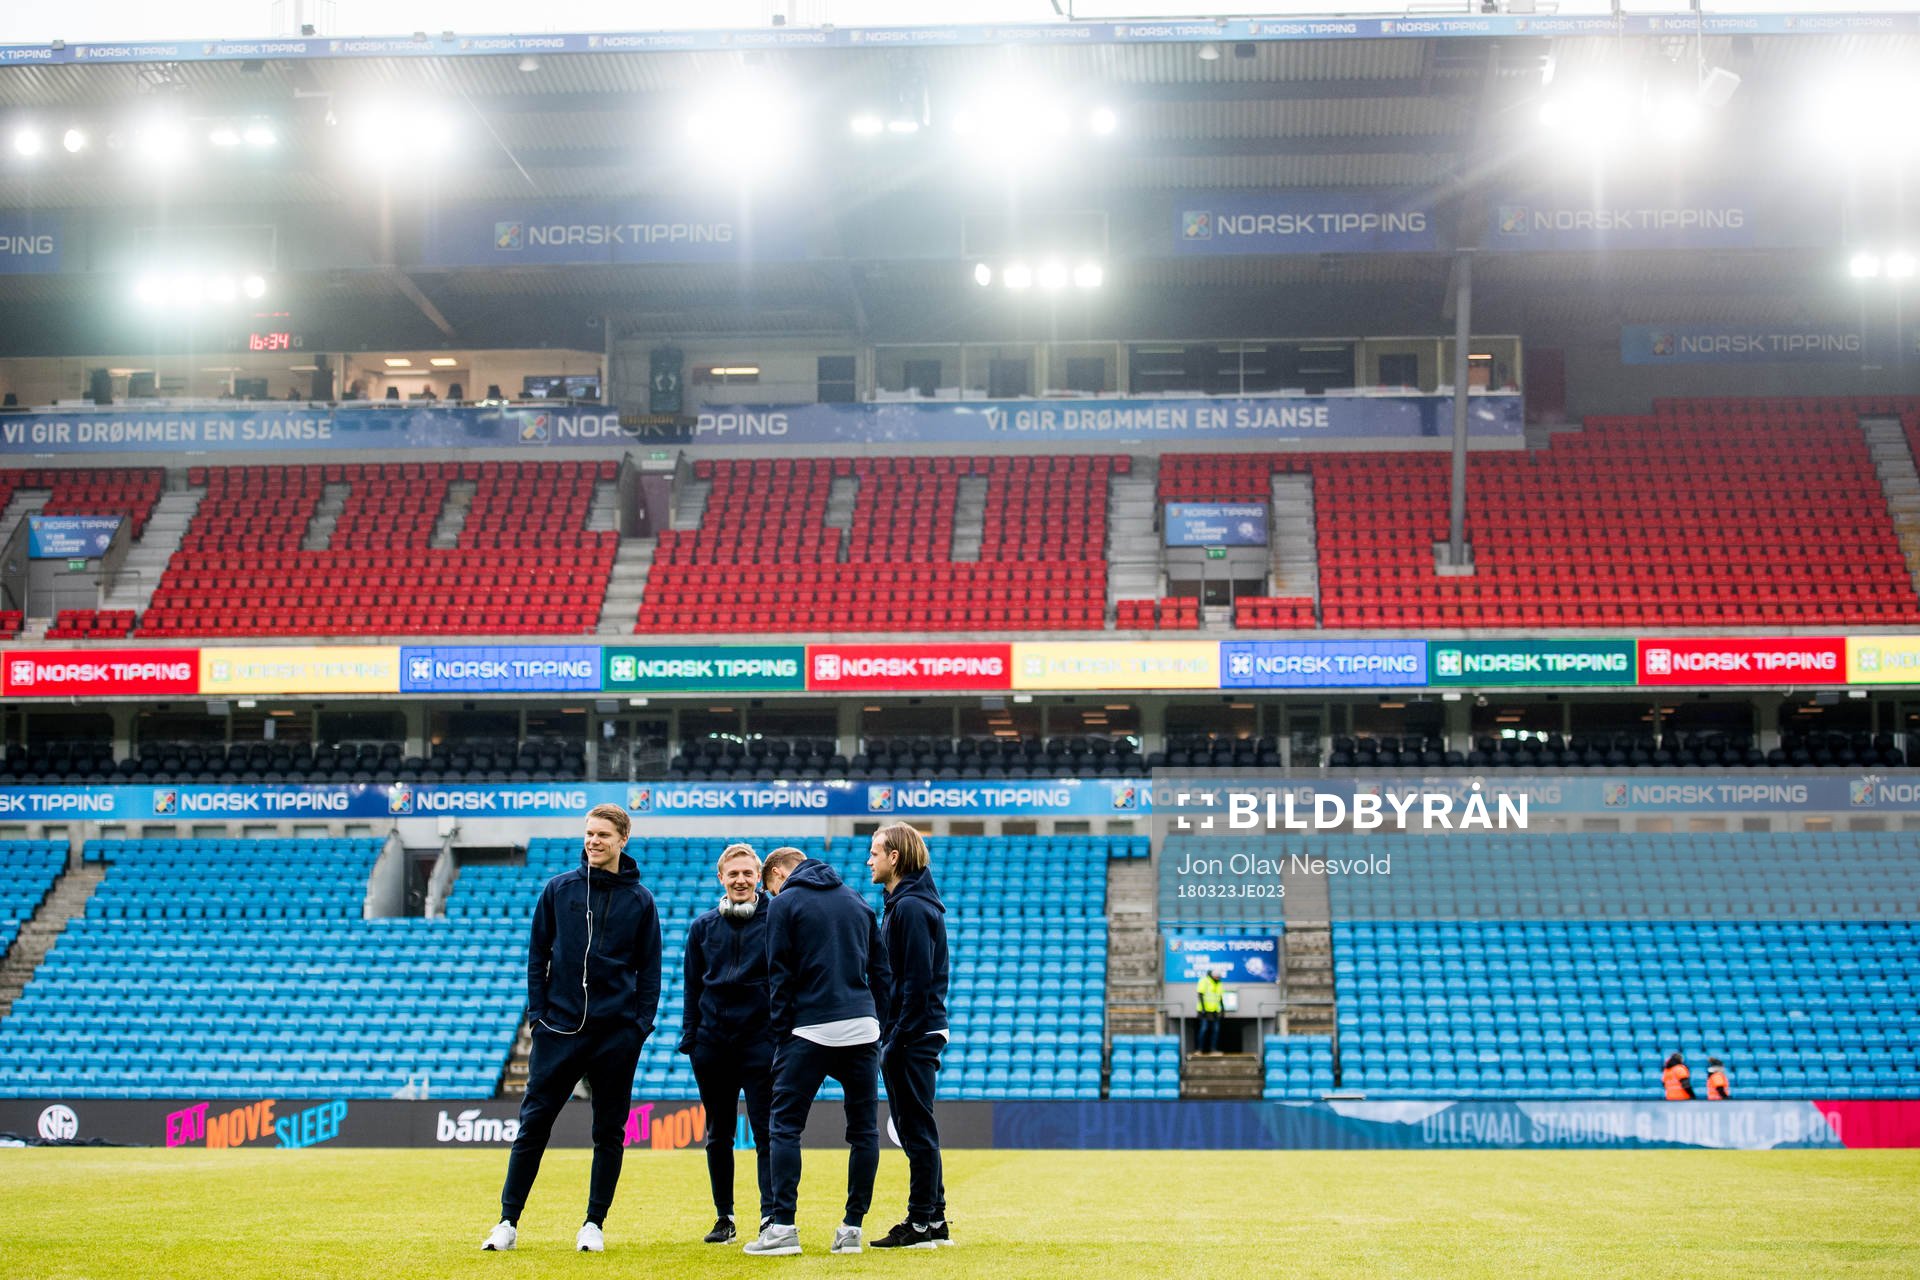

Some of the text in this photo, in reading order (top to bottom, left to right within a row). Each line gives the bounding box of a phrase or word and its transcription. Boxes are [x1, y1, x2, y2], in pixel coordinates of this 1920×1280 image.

[1130, 26, 1222, 37] NORSK TIPPING
[1263, 23, 1356, 34] NORSK TIPPING
[1396, 21, 1489, 32] NORSK TIPPING
[1532, 20, 1624, 30] NORSK TIPPING
[1664, 19, 1758, 29] NORSK TIPPING
[474, 39, 564, 50] NORSK TIPPING
[865, 31, 958, 41] NORSK TIPPING
[7, 49, 52, 60] TIPPING
[90, 46, 177, 57] NORSK TIPPING
[217, 43, 306, 55] NORSK TIPPING
[1218, 212, 1426, 235] NORSK TIPPING
[1535, 208, 1744, 230] NORSK TIPPING
[529, 223, 732, 245] NORSK TIPPING
[249, 333, 289, 350] 16:34
[1681, 334, 1860, 352] NORSK TIPPING
[986, 407, 1329, 431] VI GIR DRØMMEN EN SJANSE
[3, 419, 332, 443] VI GIR DRØMMEN EN SJANSE
[1184, 507, 1263, 517] NORSK TIPPING
[44, 520, 119, 531] NORSK TIPPING
[435, 660, 592, 679] NORSK TIPPING
[638, 659, 797, 678] NORSK TIPPING
[841, 657, 1002, 676] NORSK TIPPING
[1256, 655, 1417, 674] NORSK TIPPING
[1464, 653, 1627, 672] NORSK TIPPING
[1673, 652, 1836, 671] NORSK TIPPING
[36, 662, 191, 681] NORSK TIPPING
[29, 793, 114, 811] TIPPING
[181, 792, 349, 811] NORSK TIPPING
[417, 790, 587, 810] NORSK TIPPING
[656, 789, 828, 809] NORSK TIPPING
[897, 788, 1070, 808] NORSK TIPPING
[1632, 784, 1808, 803] NORSK TIPPING
[166, 1099, 348, 1149] EAT MOVE SLEEP
[652, 1104, 706, 1149] MOV
[1422, 1112, 1524, 1145] ULLEVAAL
[1531, 1111, 1625, 1144] STADION
[1666, 1111, 1720, 1144] JUNI
